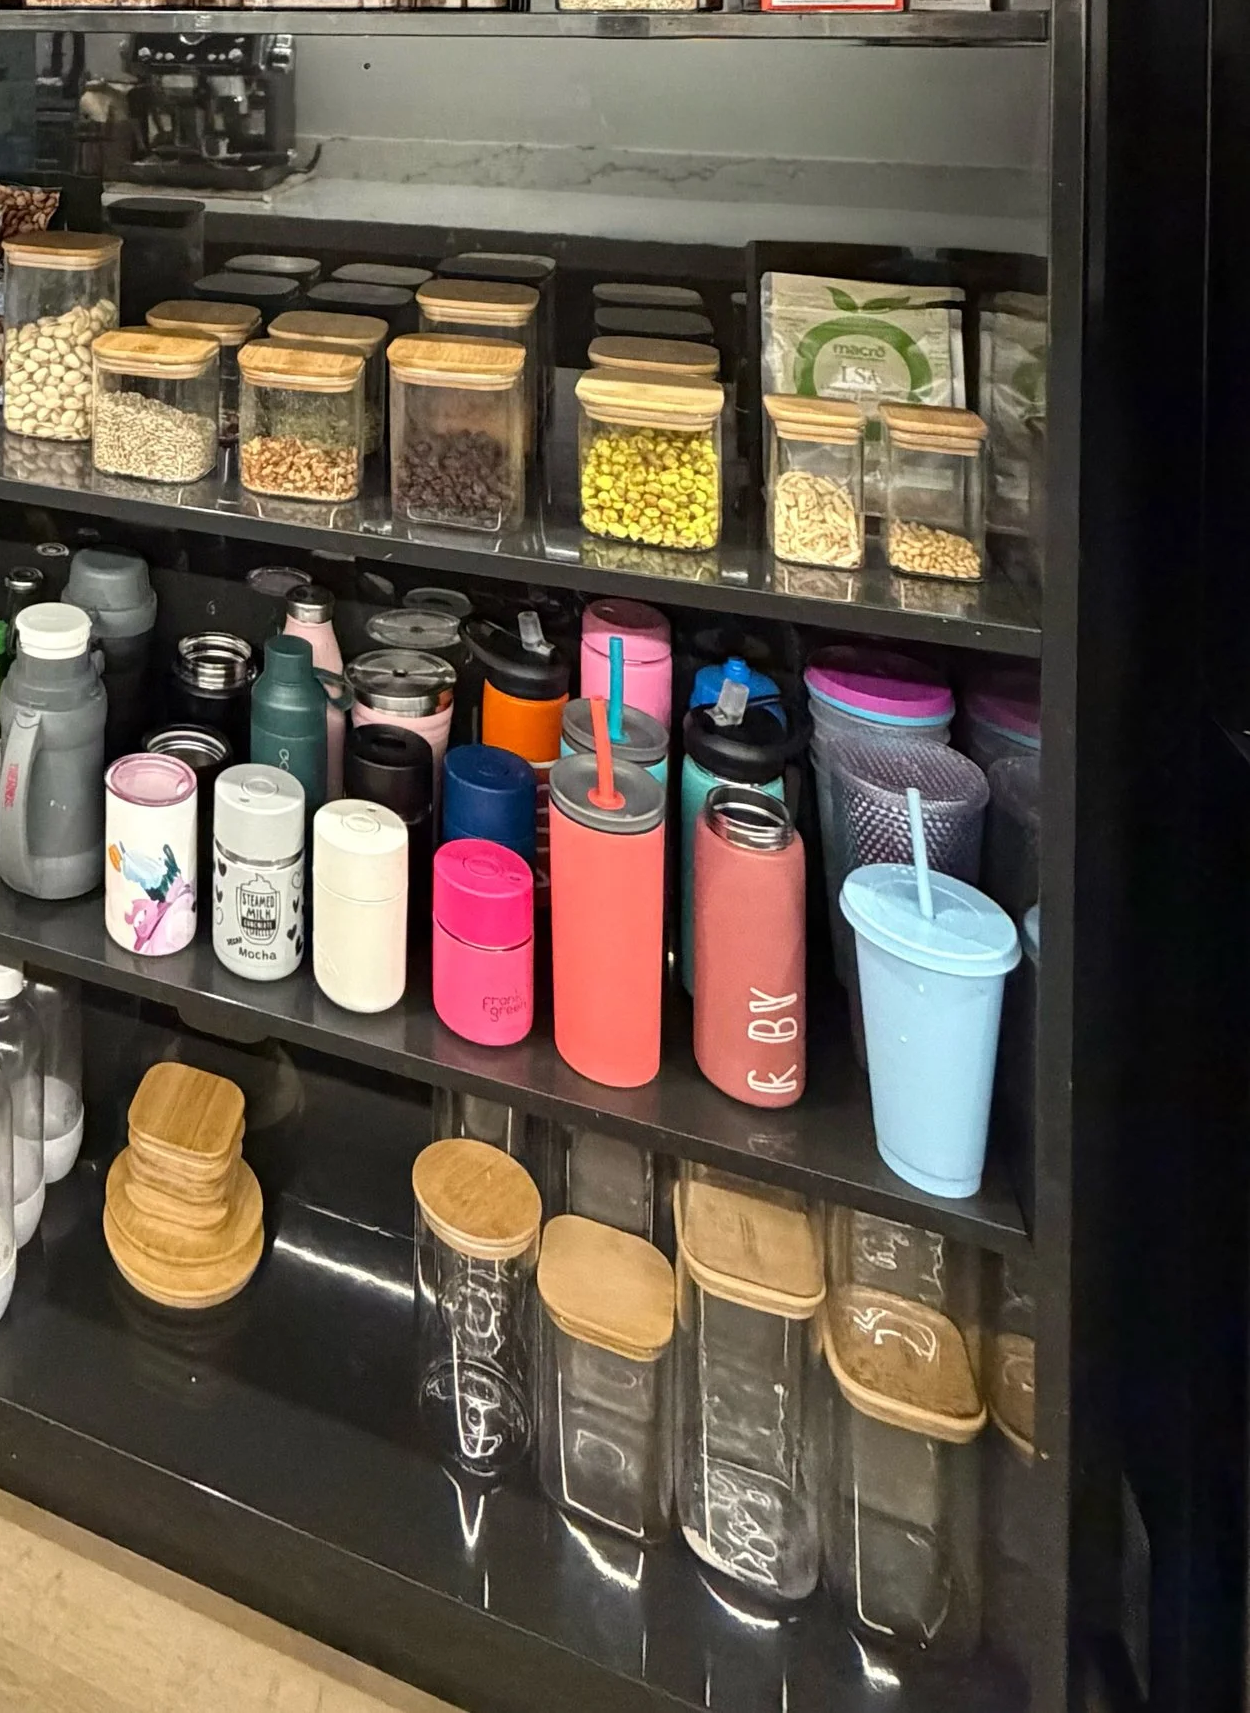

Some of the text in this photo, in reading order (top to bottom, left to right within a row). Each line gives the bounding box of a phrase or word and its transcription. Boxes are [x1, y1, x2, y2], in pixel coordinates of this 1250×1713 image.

[833, 343, 886, 359] macro
[242, 892, 275, 908] STEAMED
[246, 907, 272, 920] MILK
[238, 946, 278, 961] Mocha
